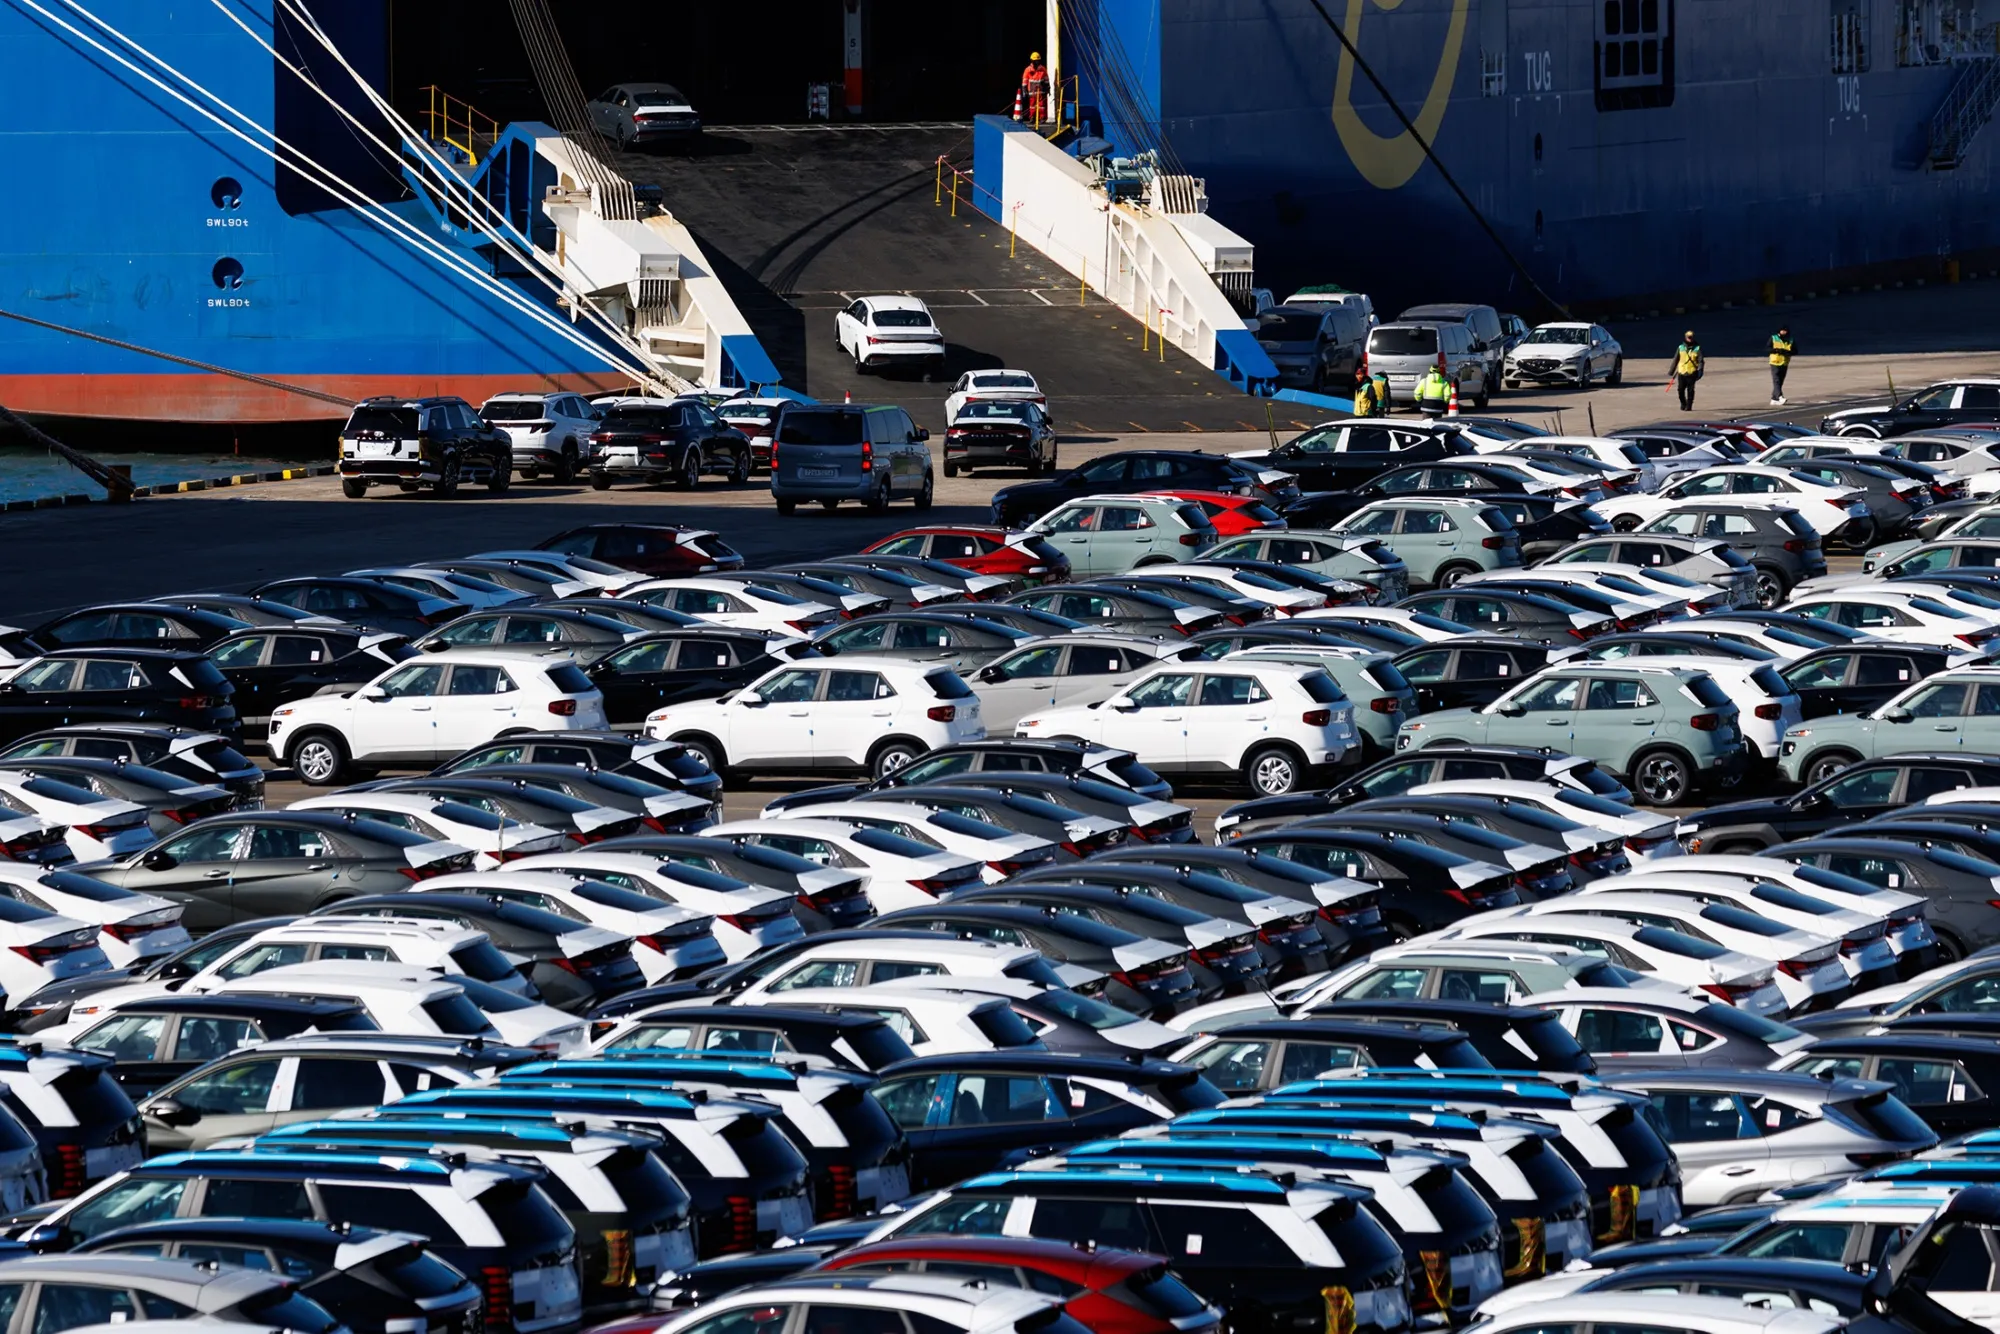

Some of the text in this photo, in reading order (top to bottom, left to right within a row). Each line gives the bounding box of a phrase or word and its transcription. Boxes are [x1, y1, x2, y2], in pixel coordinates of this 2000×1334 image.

[850, 38, 856, 47] 5
[1524, 50, 1552, 91] TUG
[1837, 76, 1861, 113] TUG
